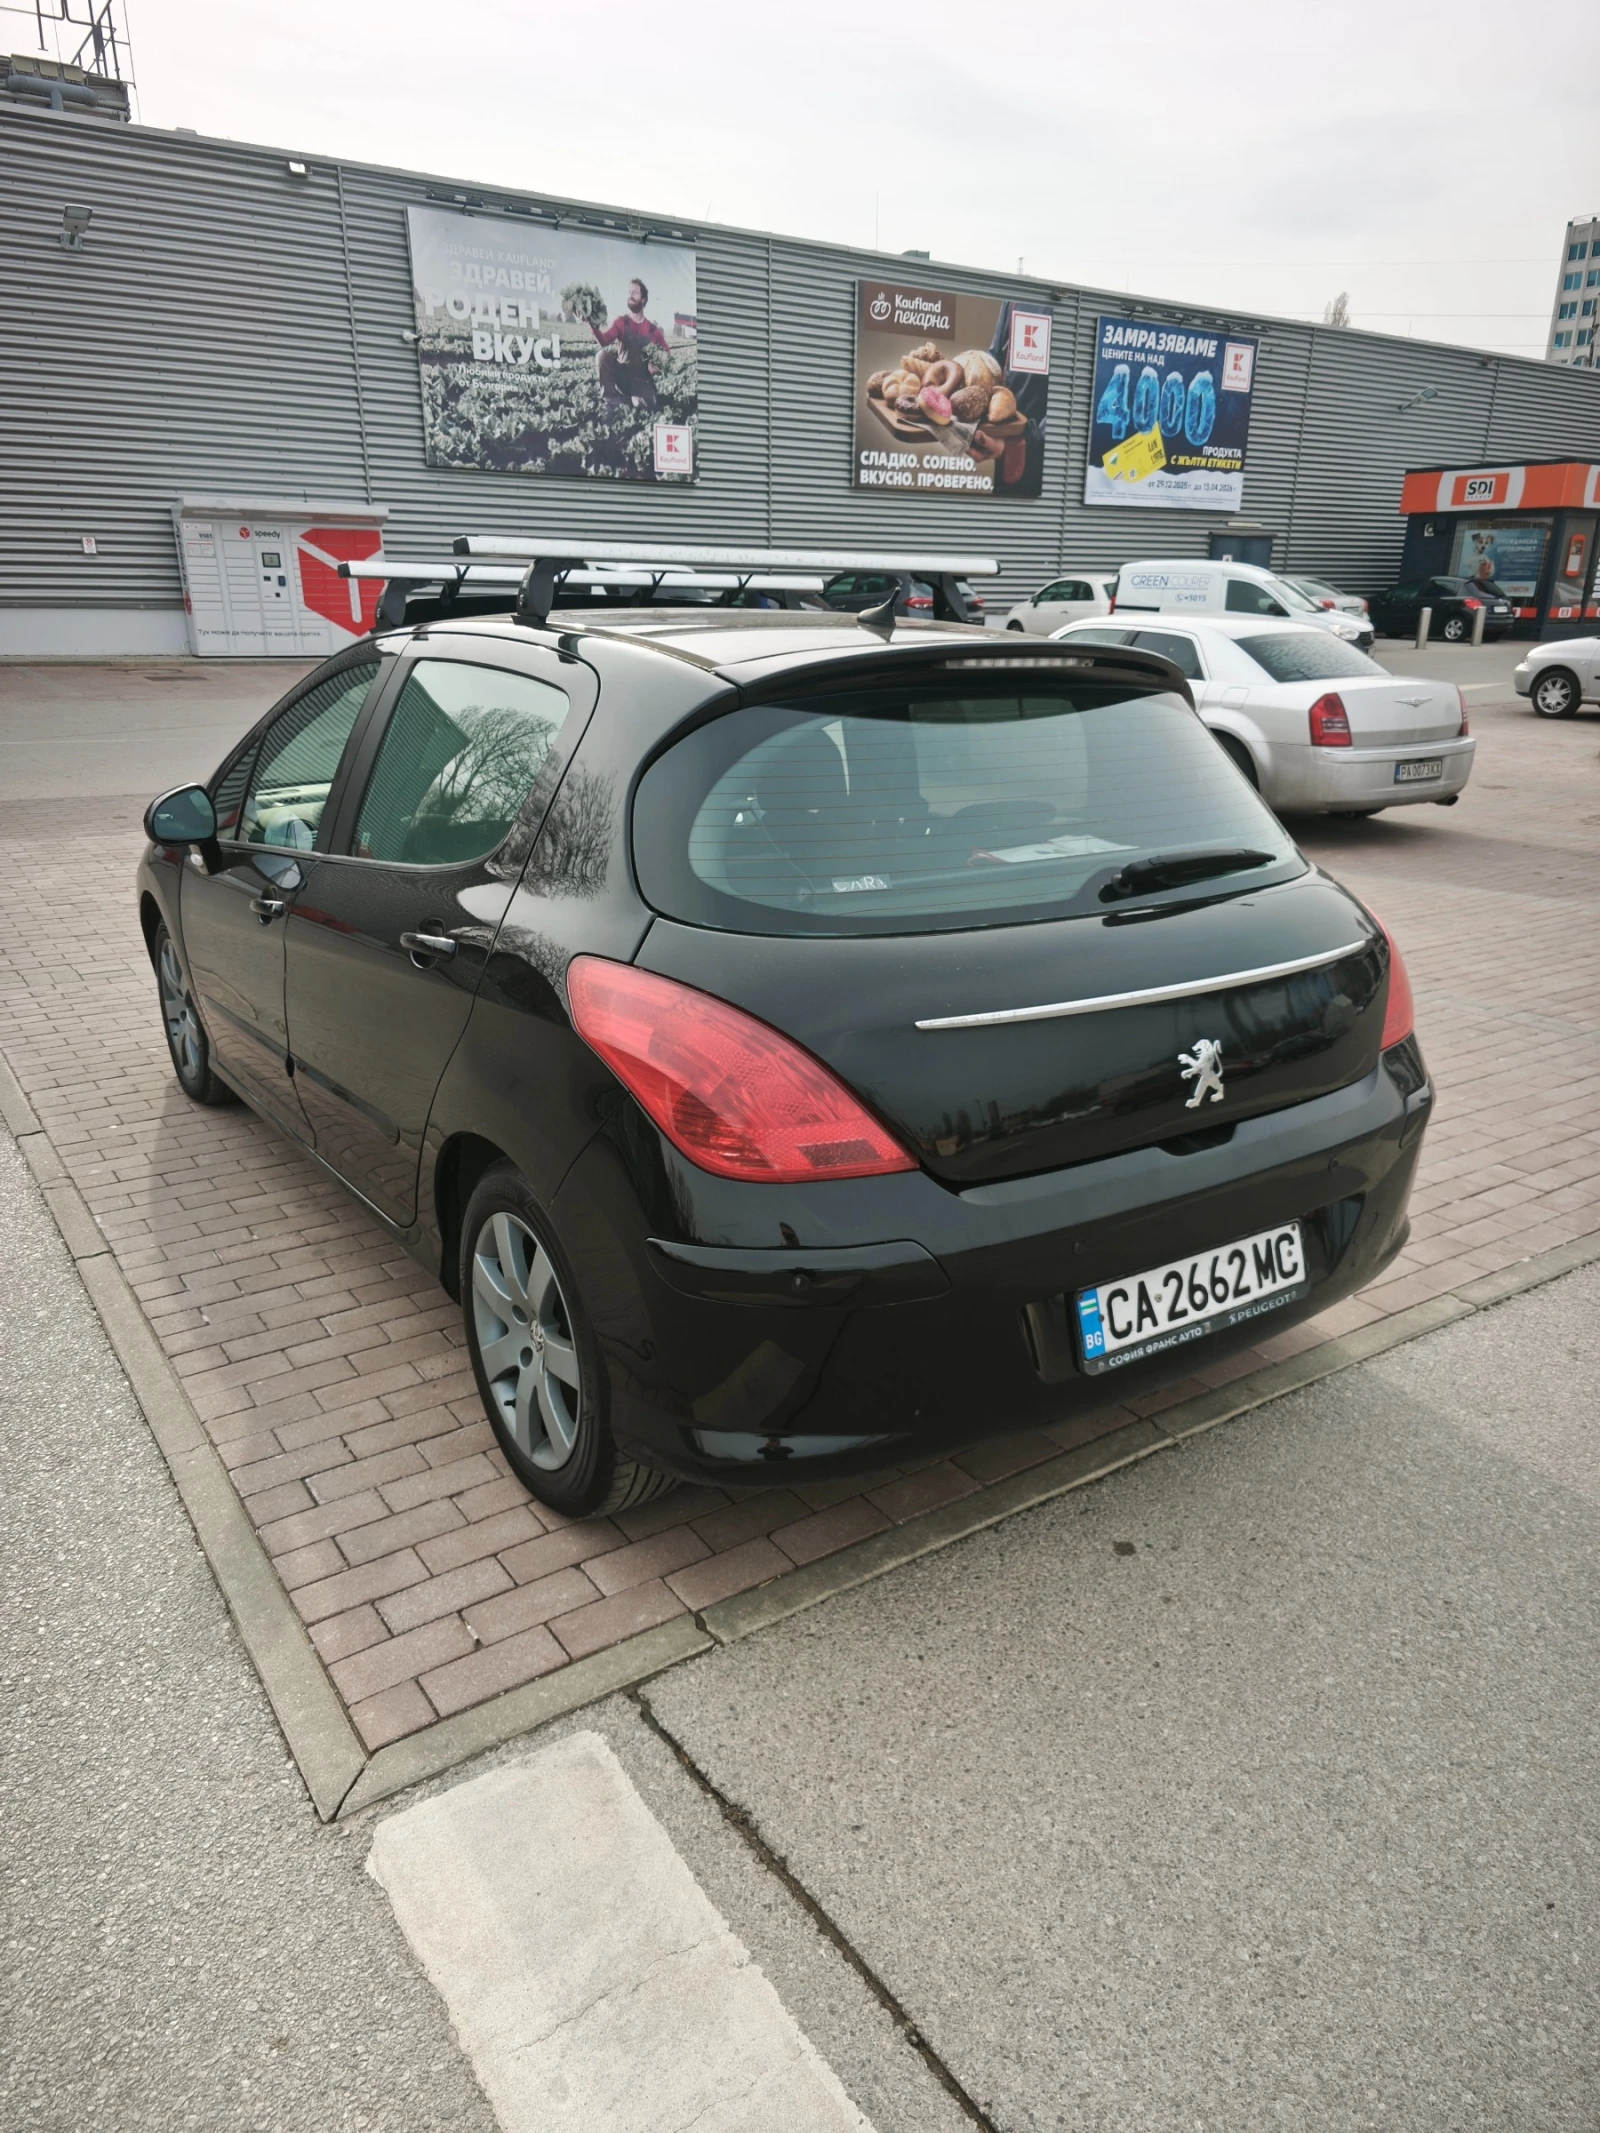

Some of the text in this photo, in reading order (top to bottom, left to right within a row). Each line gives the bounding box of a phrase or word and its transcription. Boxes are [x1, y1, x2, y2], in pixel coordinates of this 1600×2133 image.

[450, 261, 555, 298] ЗДРАВЕЙ,
[423, 285, 540, 330] РОДЕН
[894, 294, 942, 313] Kaufland
[894, 310, 950, 331] пекарна
[472, 330, 561, 369] ВКУС!
[1102, 325, 1218, 358] ЗАМРАЗЯВАМЕ
[1015, 352, 1044, 363] Kaufland
[1101, 348, 1165, 367] ЦЕНИТЕ НА НАД
[458, 364, 501, 380] Любими
[1096, 364, 1216, 446] 4000
[860, 450, 976, 472] СЛАДКО. СОЛЕНО.
[1202, 446, 1242, 458] ПРОДУКТА
[1170, 455, 1242, 470] С ЖЪЛТИ ЕТИКЕТИ
[860, 469, 994, 491] ВКУСНО. ПРОВЕРЕНО.
[1468, 480, 1493, 495] SDI
[254, 530, 281, 540] speedy
[1130, 574, 1212, 588] GREEN COURIER
[1237, 1294, 1292, 1322] PEUGEOT
[1085, 1330, 1103, 1350] BG
[1108, 1326, 1203, 1367] СОФИЯ ФРАНС АУТО
